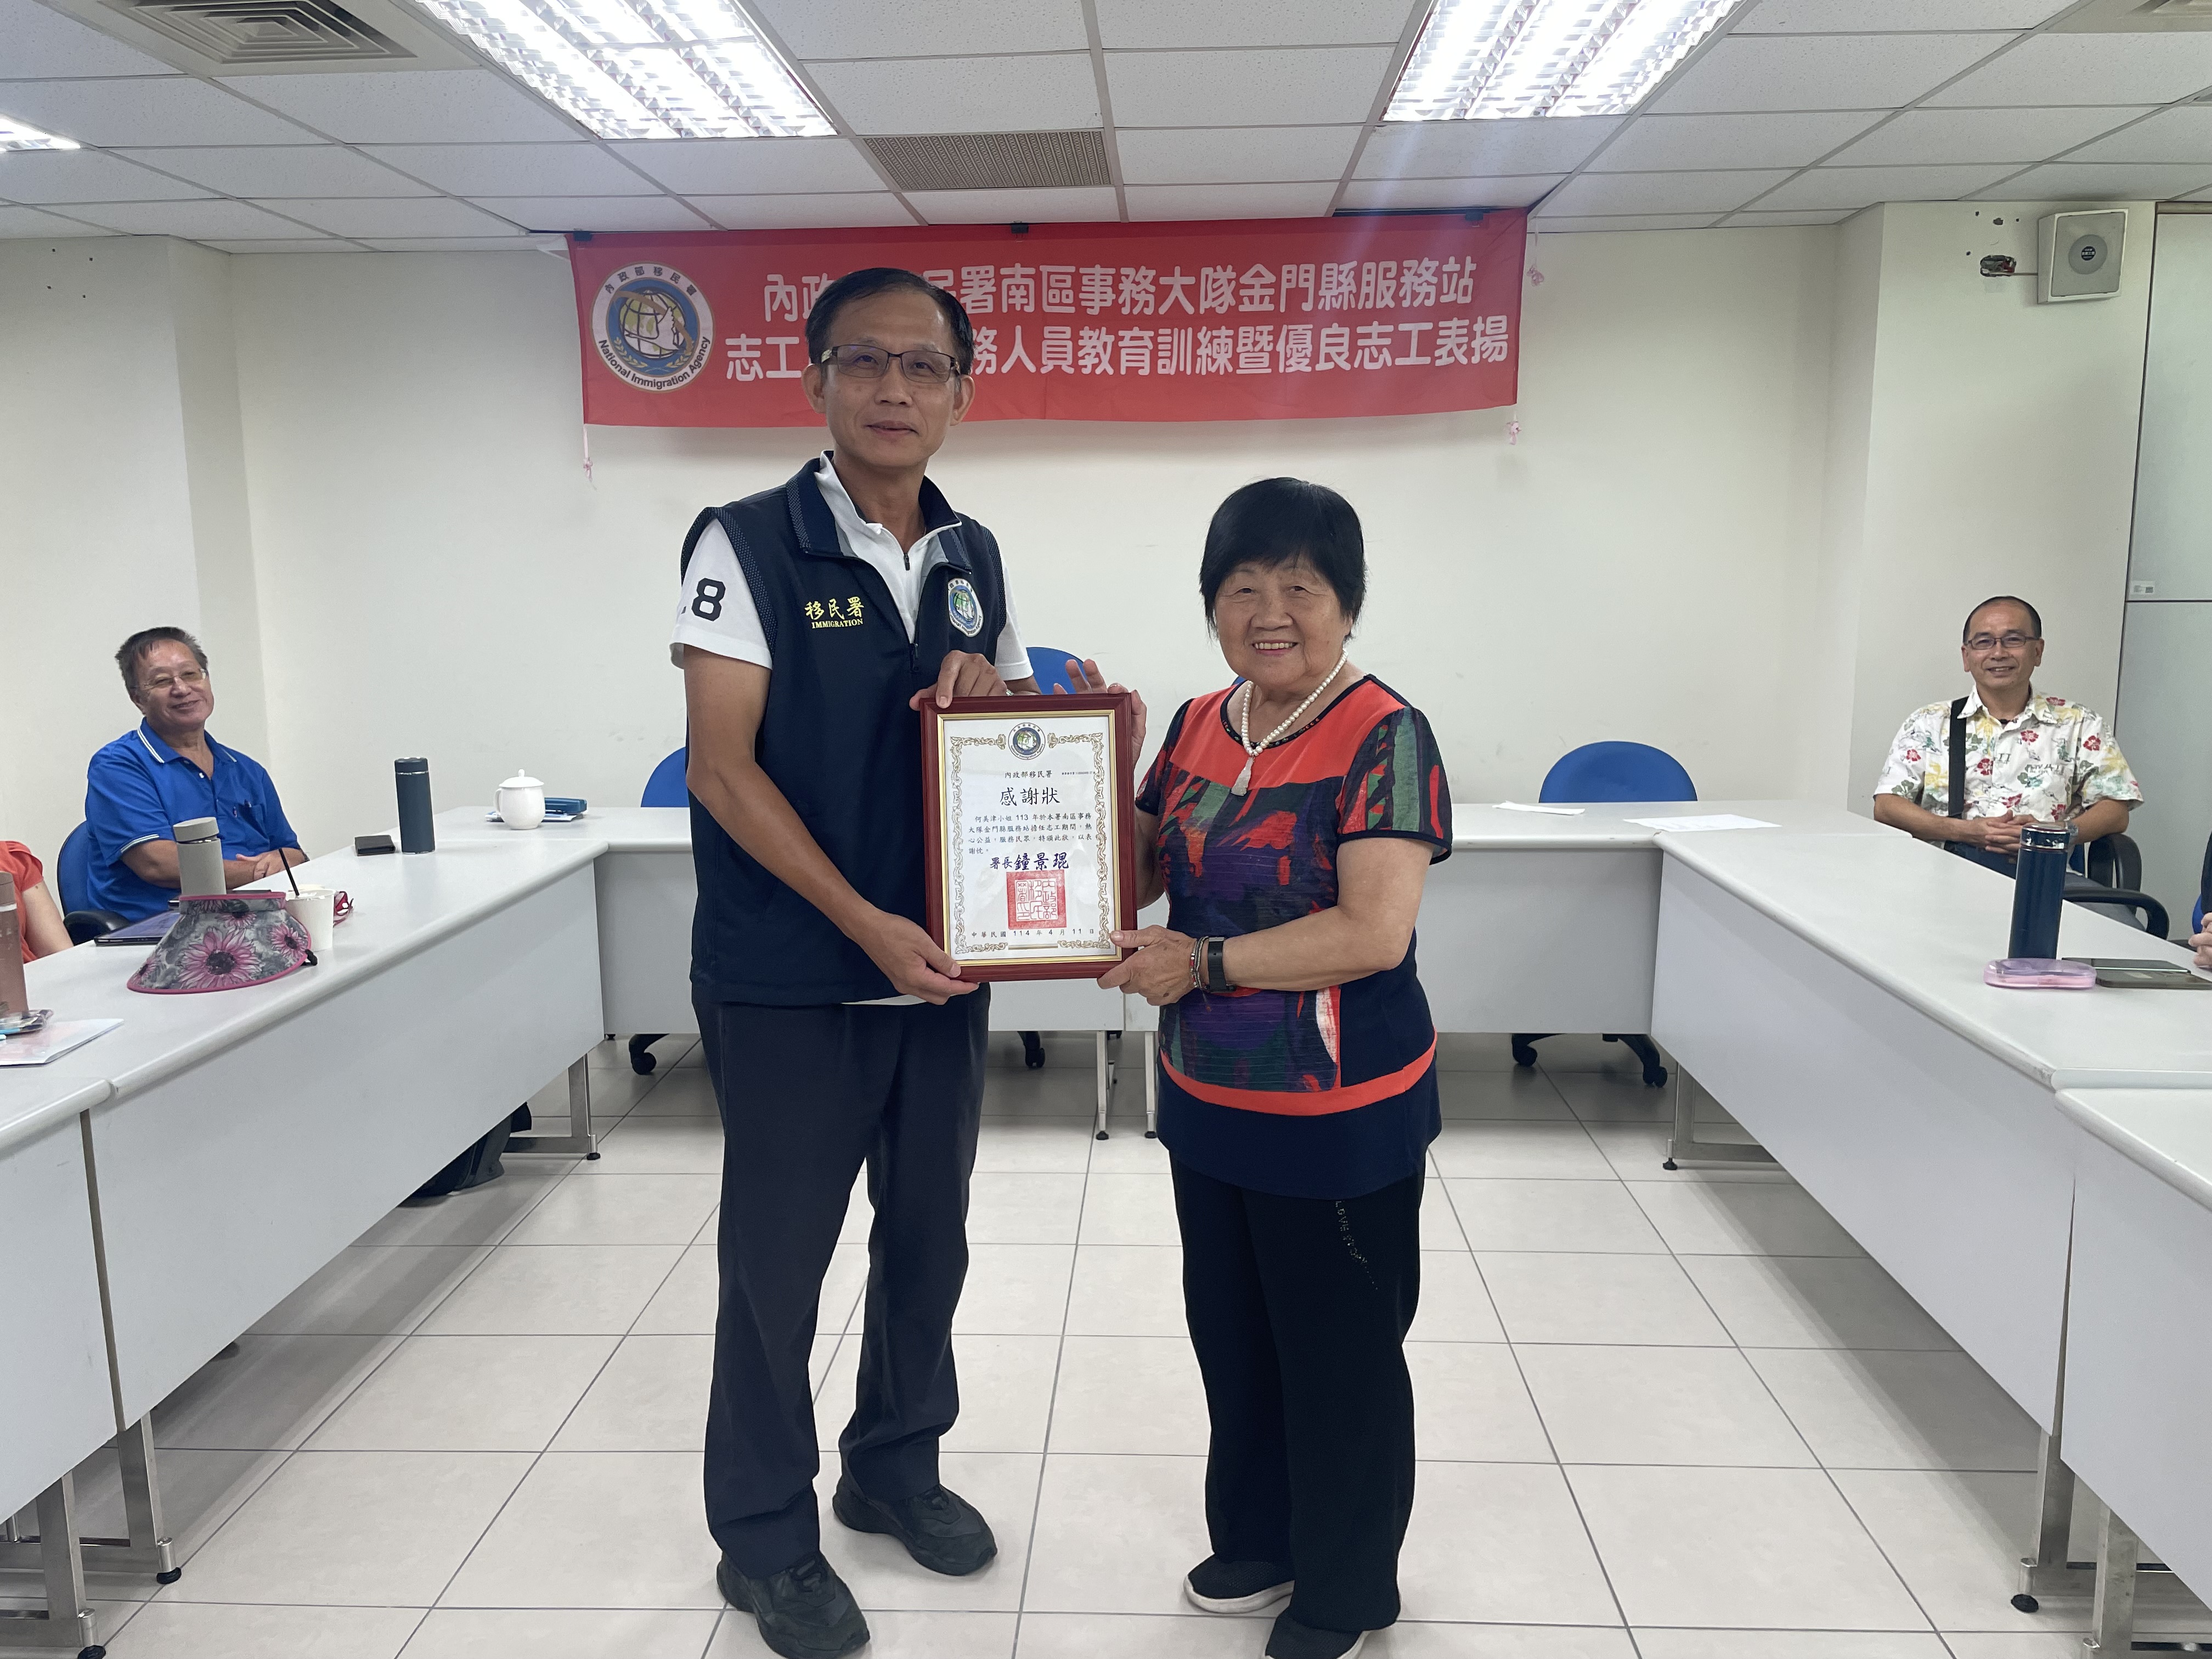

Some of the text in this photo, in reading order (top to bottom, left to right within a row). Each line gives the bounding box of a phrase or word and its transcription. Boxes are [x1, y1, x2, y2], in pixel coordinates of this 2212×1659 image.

[605, 266, 697, 296] 內政部移民署
[599, 336, 711, 390] National Immigration Agency
[681, 578, 726, 622] 8
[804, 596, 865, 620] 移民署
[811, 617, 864, 629] IMMIGRATION
[1005, 770, 1053, 779] 內政部移民署
[1000, 787, 1060, 806] 感謝狀
